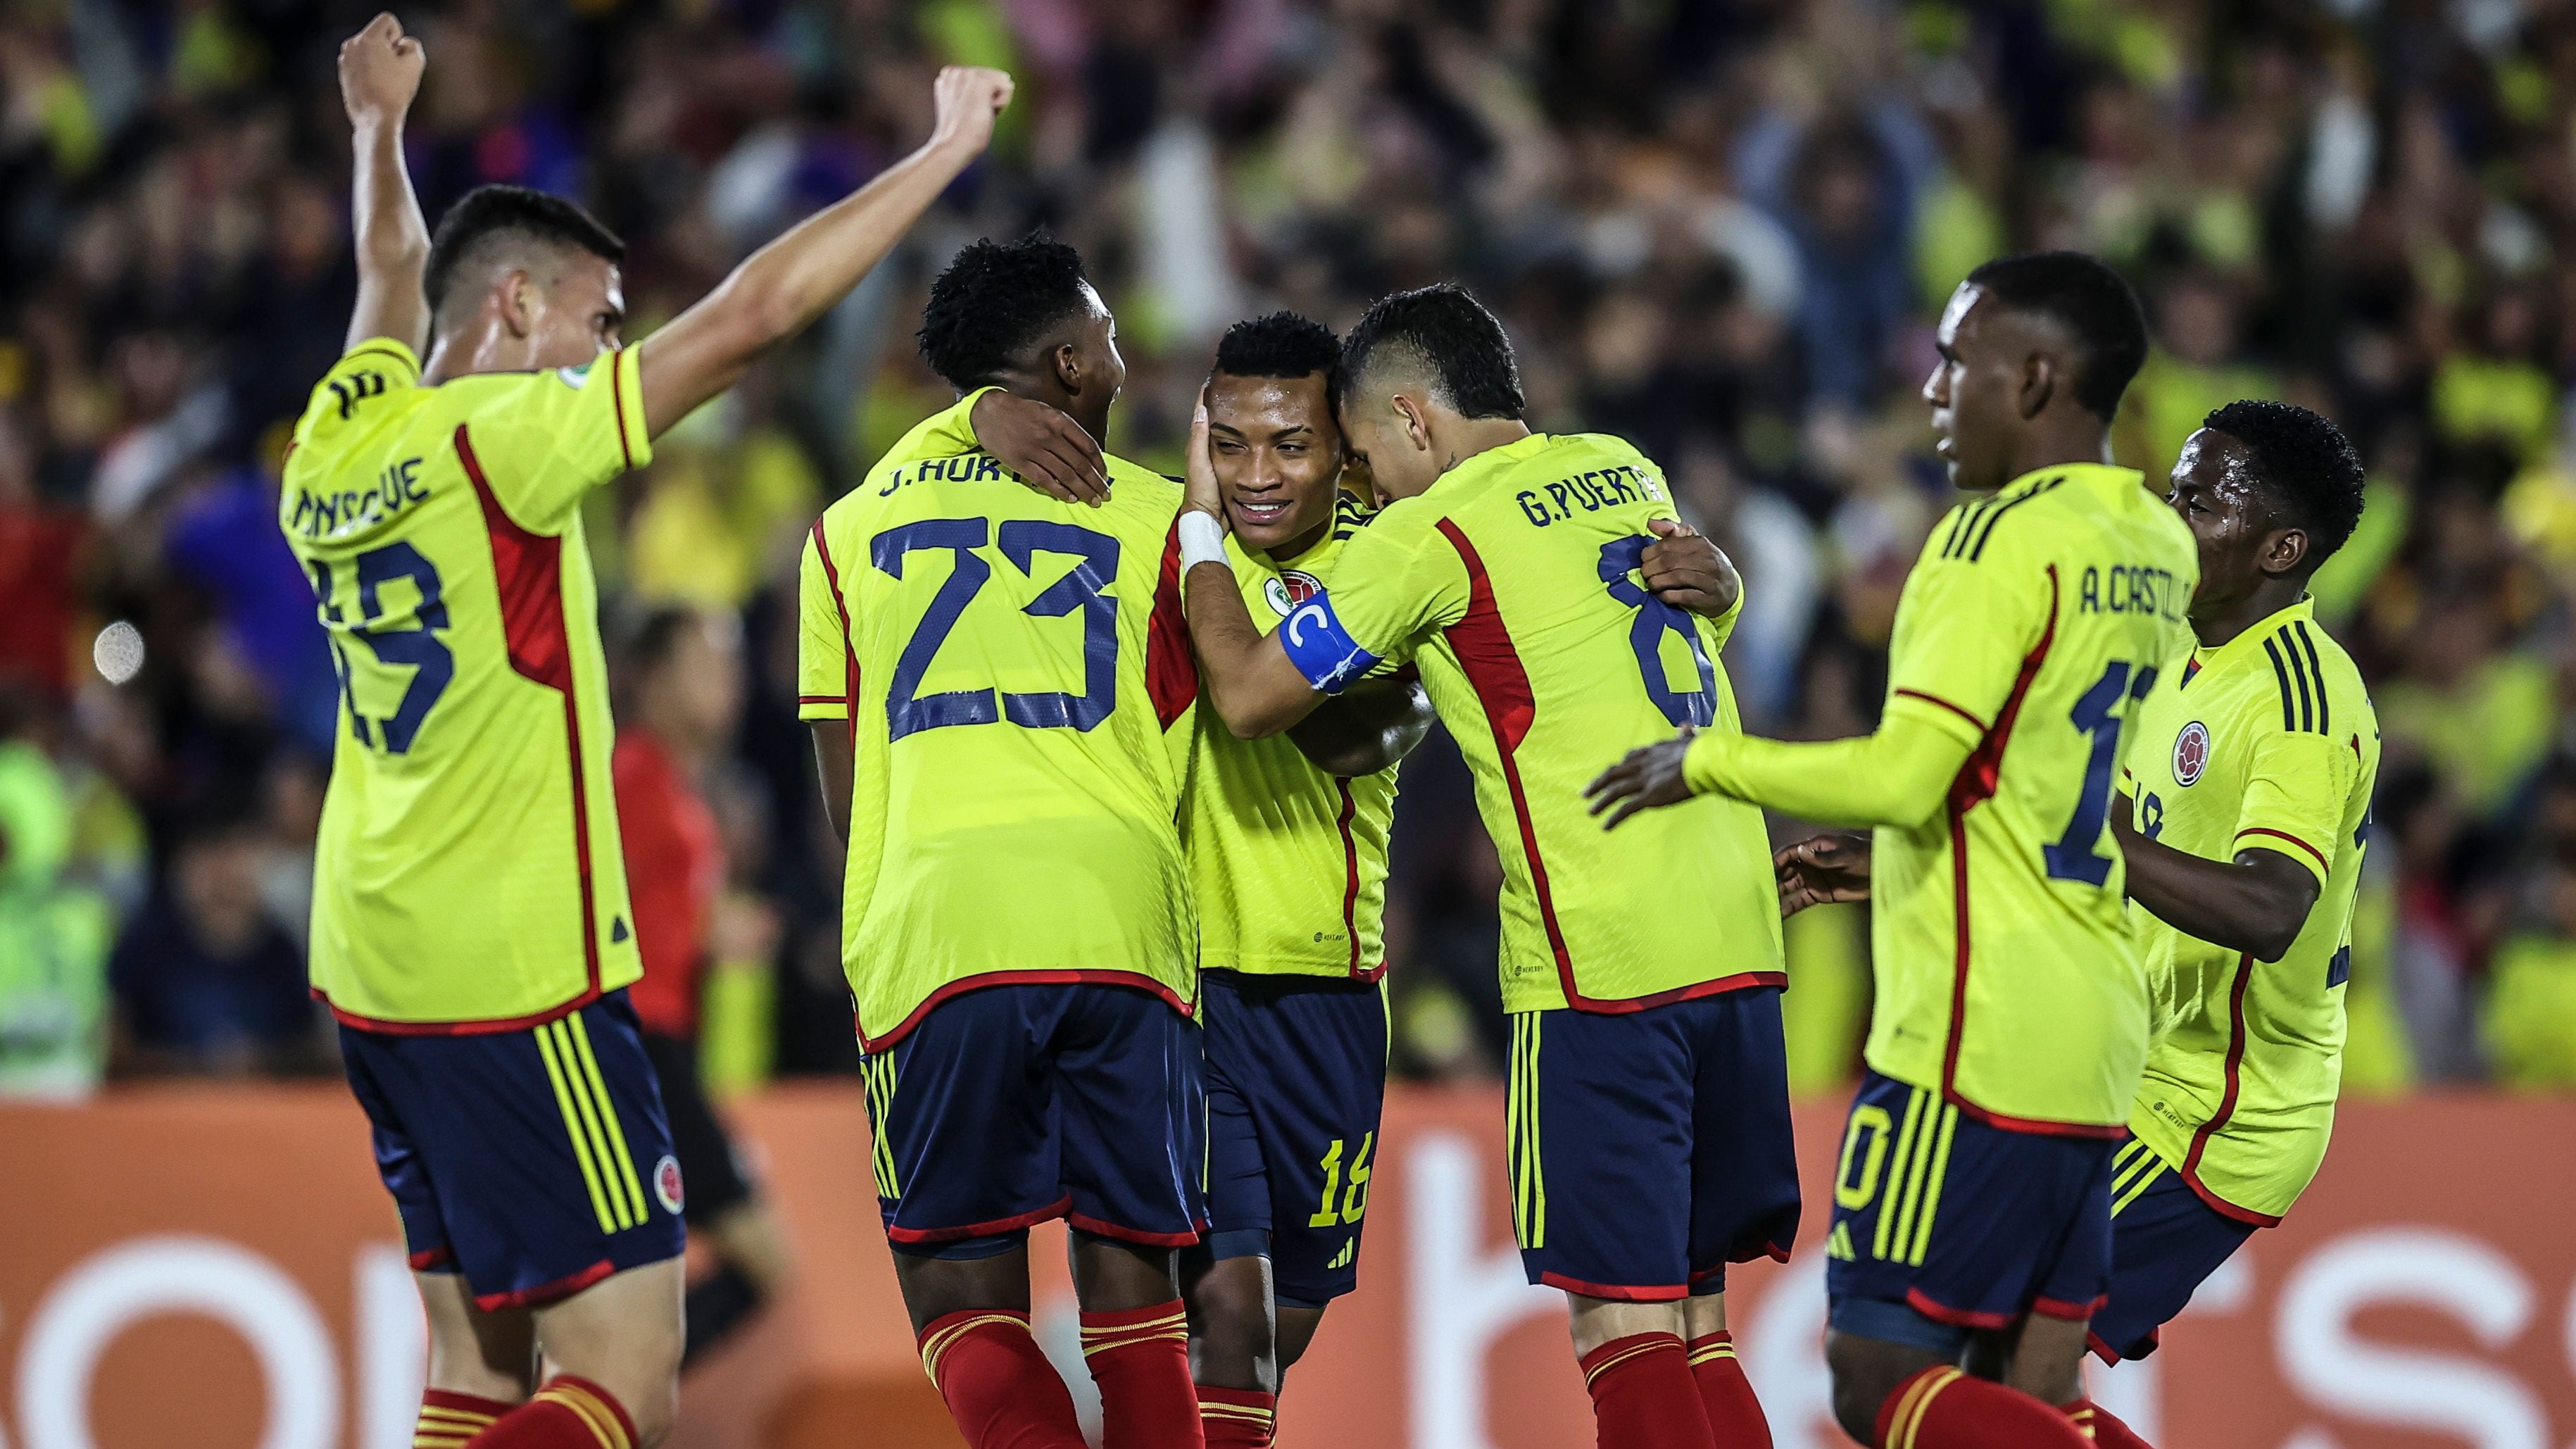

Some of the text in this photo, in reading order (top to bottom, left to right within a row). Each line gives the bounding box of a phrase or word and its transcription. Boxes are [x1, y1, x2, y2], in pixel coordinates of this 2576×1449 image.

[870, 516, 1121, 744] 23
[1288, 604, 1328, 648] C
[1597, 533, 1718, 728] 8
[2041, 660, 2157, 887] 1
[1308, 1130, 1374, 1227] 16
